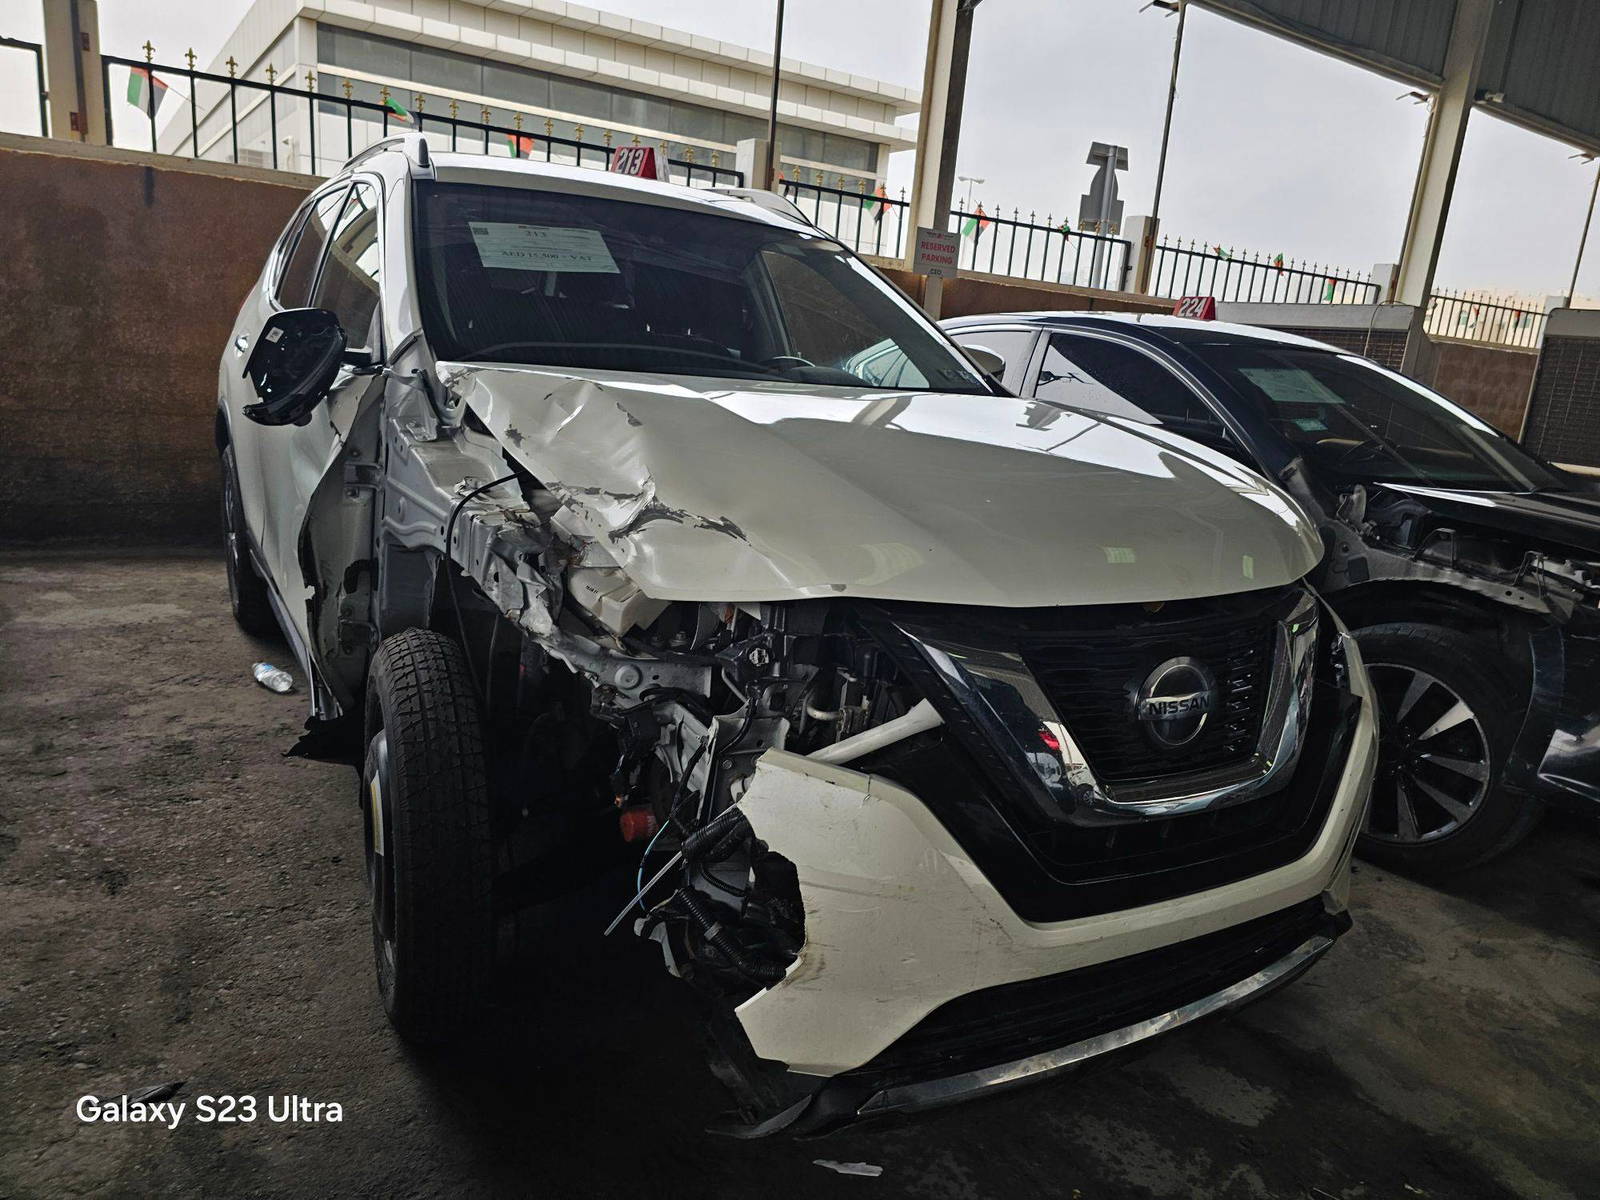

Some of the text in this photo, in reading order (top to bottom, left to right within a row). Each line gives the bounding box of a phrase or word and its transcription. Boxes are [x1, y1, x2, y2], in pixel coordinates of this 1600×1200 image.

[615, 148, 644, 175] 213
[921, 241, 956, 254] RESERVED
[921, 253, 953, 265] PARKING
[1177, 297, 1207, 318] 224
[1148, 695, 1209, 715] NISSAN
